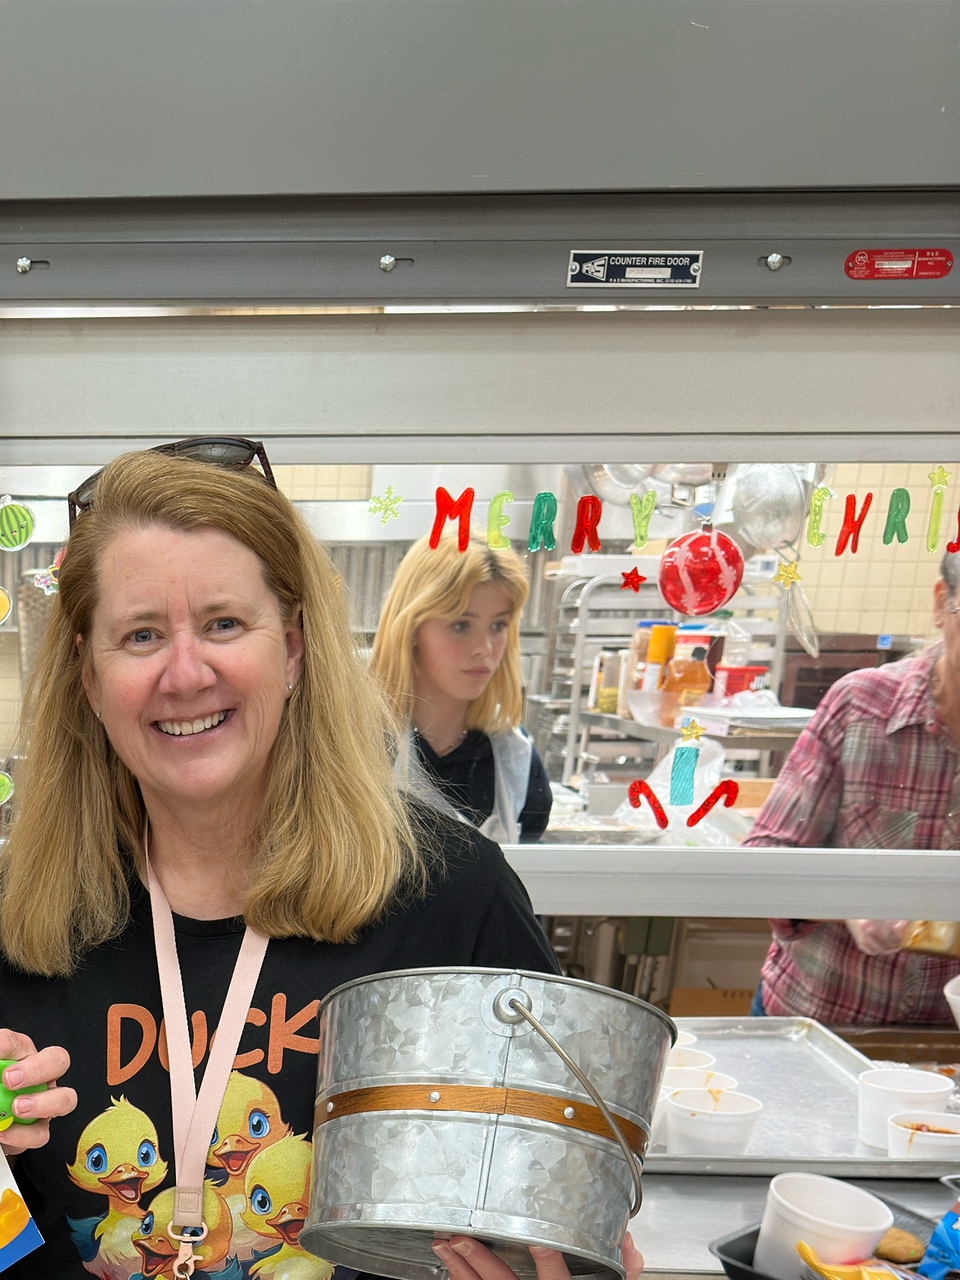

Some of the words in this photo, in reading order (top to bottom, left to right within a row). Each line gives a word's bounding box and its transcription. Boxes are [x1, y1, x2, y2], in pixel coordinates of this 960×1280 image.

[609, 256, 647, 265] COUNTER
[648, 257, 665, 265] FIRE
[667, 257, 691, 266] DOOR
[429, 487, 656, 553] MERRY
[807, 487, 960, 556] CHRI
